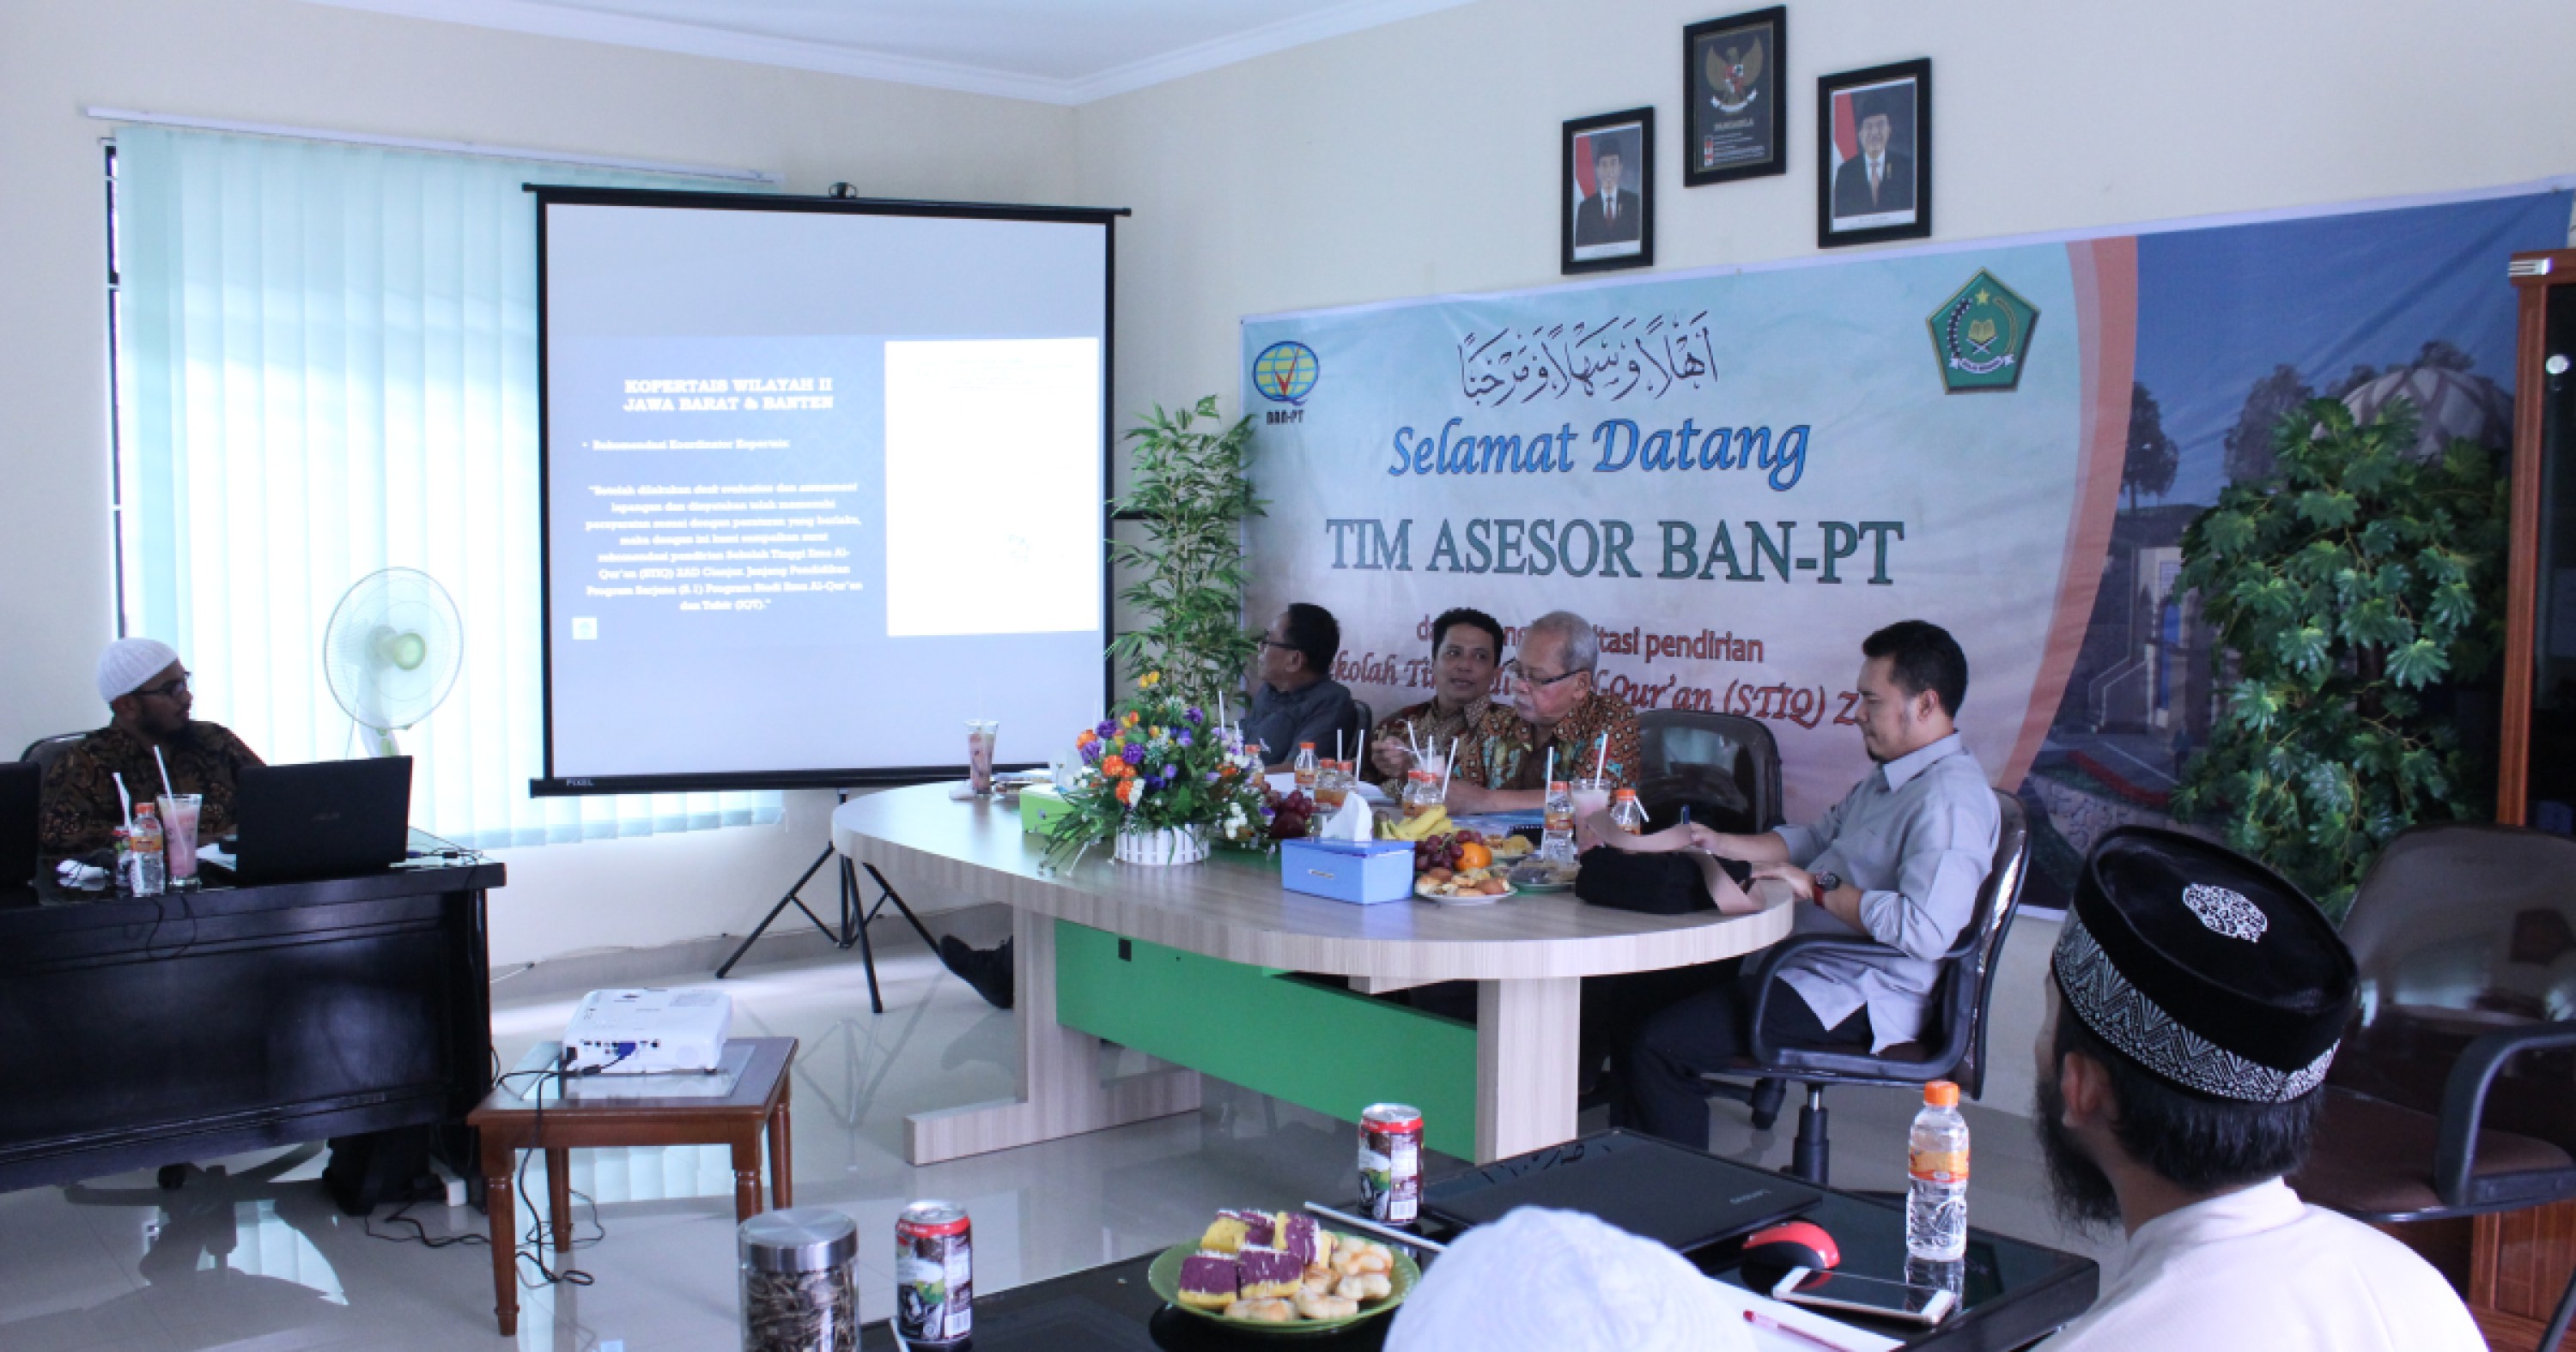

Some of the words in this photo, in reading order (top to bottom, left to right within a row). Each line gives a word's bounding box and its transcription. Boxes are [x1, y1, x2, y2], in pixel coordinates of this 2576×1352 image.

[623, 397, 675, 411] JAWA
[678, 397, 738, 410] BARAT
[762, 395, 834, 409] BANTEN
[624, 379, 728, 393] KOPERTAIS
[732, 377, 814, 391] WILAYAH
[818, 377, 833, 391] II
[1388, 415, 1579, 476] Selamat
[1592, 417, 1811, 492] Datang
[1326, 518, 1413, 572] TIM
[1425, 517, 1642, 578] ASESOR
[1657, 519, 1905, 585] BAN-PT
[1644, 628, 1764, 664] pendirian
[1723, 677, 1826, 730] (STIQ)
